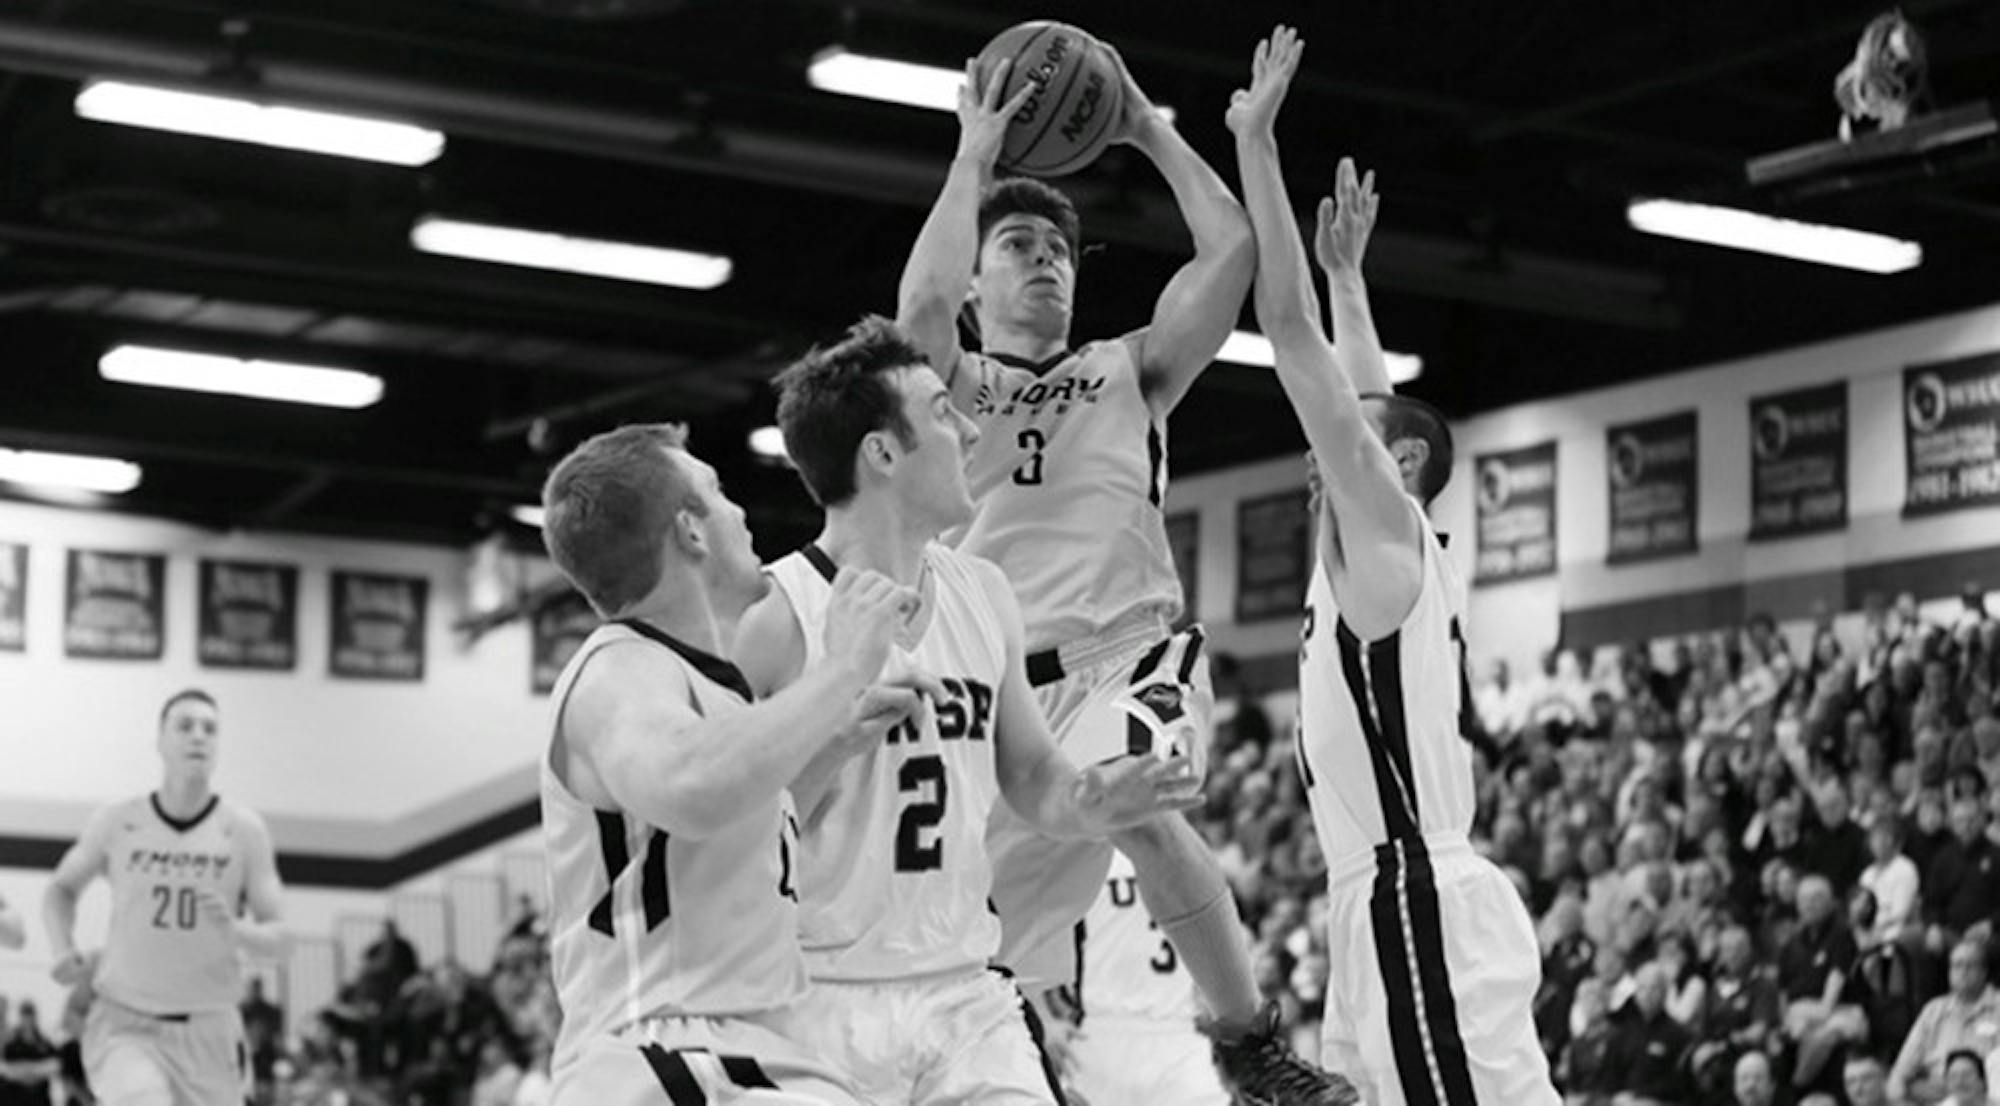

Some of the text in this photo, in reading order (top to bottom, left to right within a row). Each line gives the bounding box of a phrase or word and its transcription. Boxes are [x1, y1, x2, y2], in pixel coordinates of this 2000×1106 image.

[1059, 70, 1107, 144] NCAA
[1012, 427, 1046, 486] 3
[895, 753, 948, 874] 2
[151, 884, 198, 930] 20
